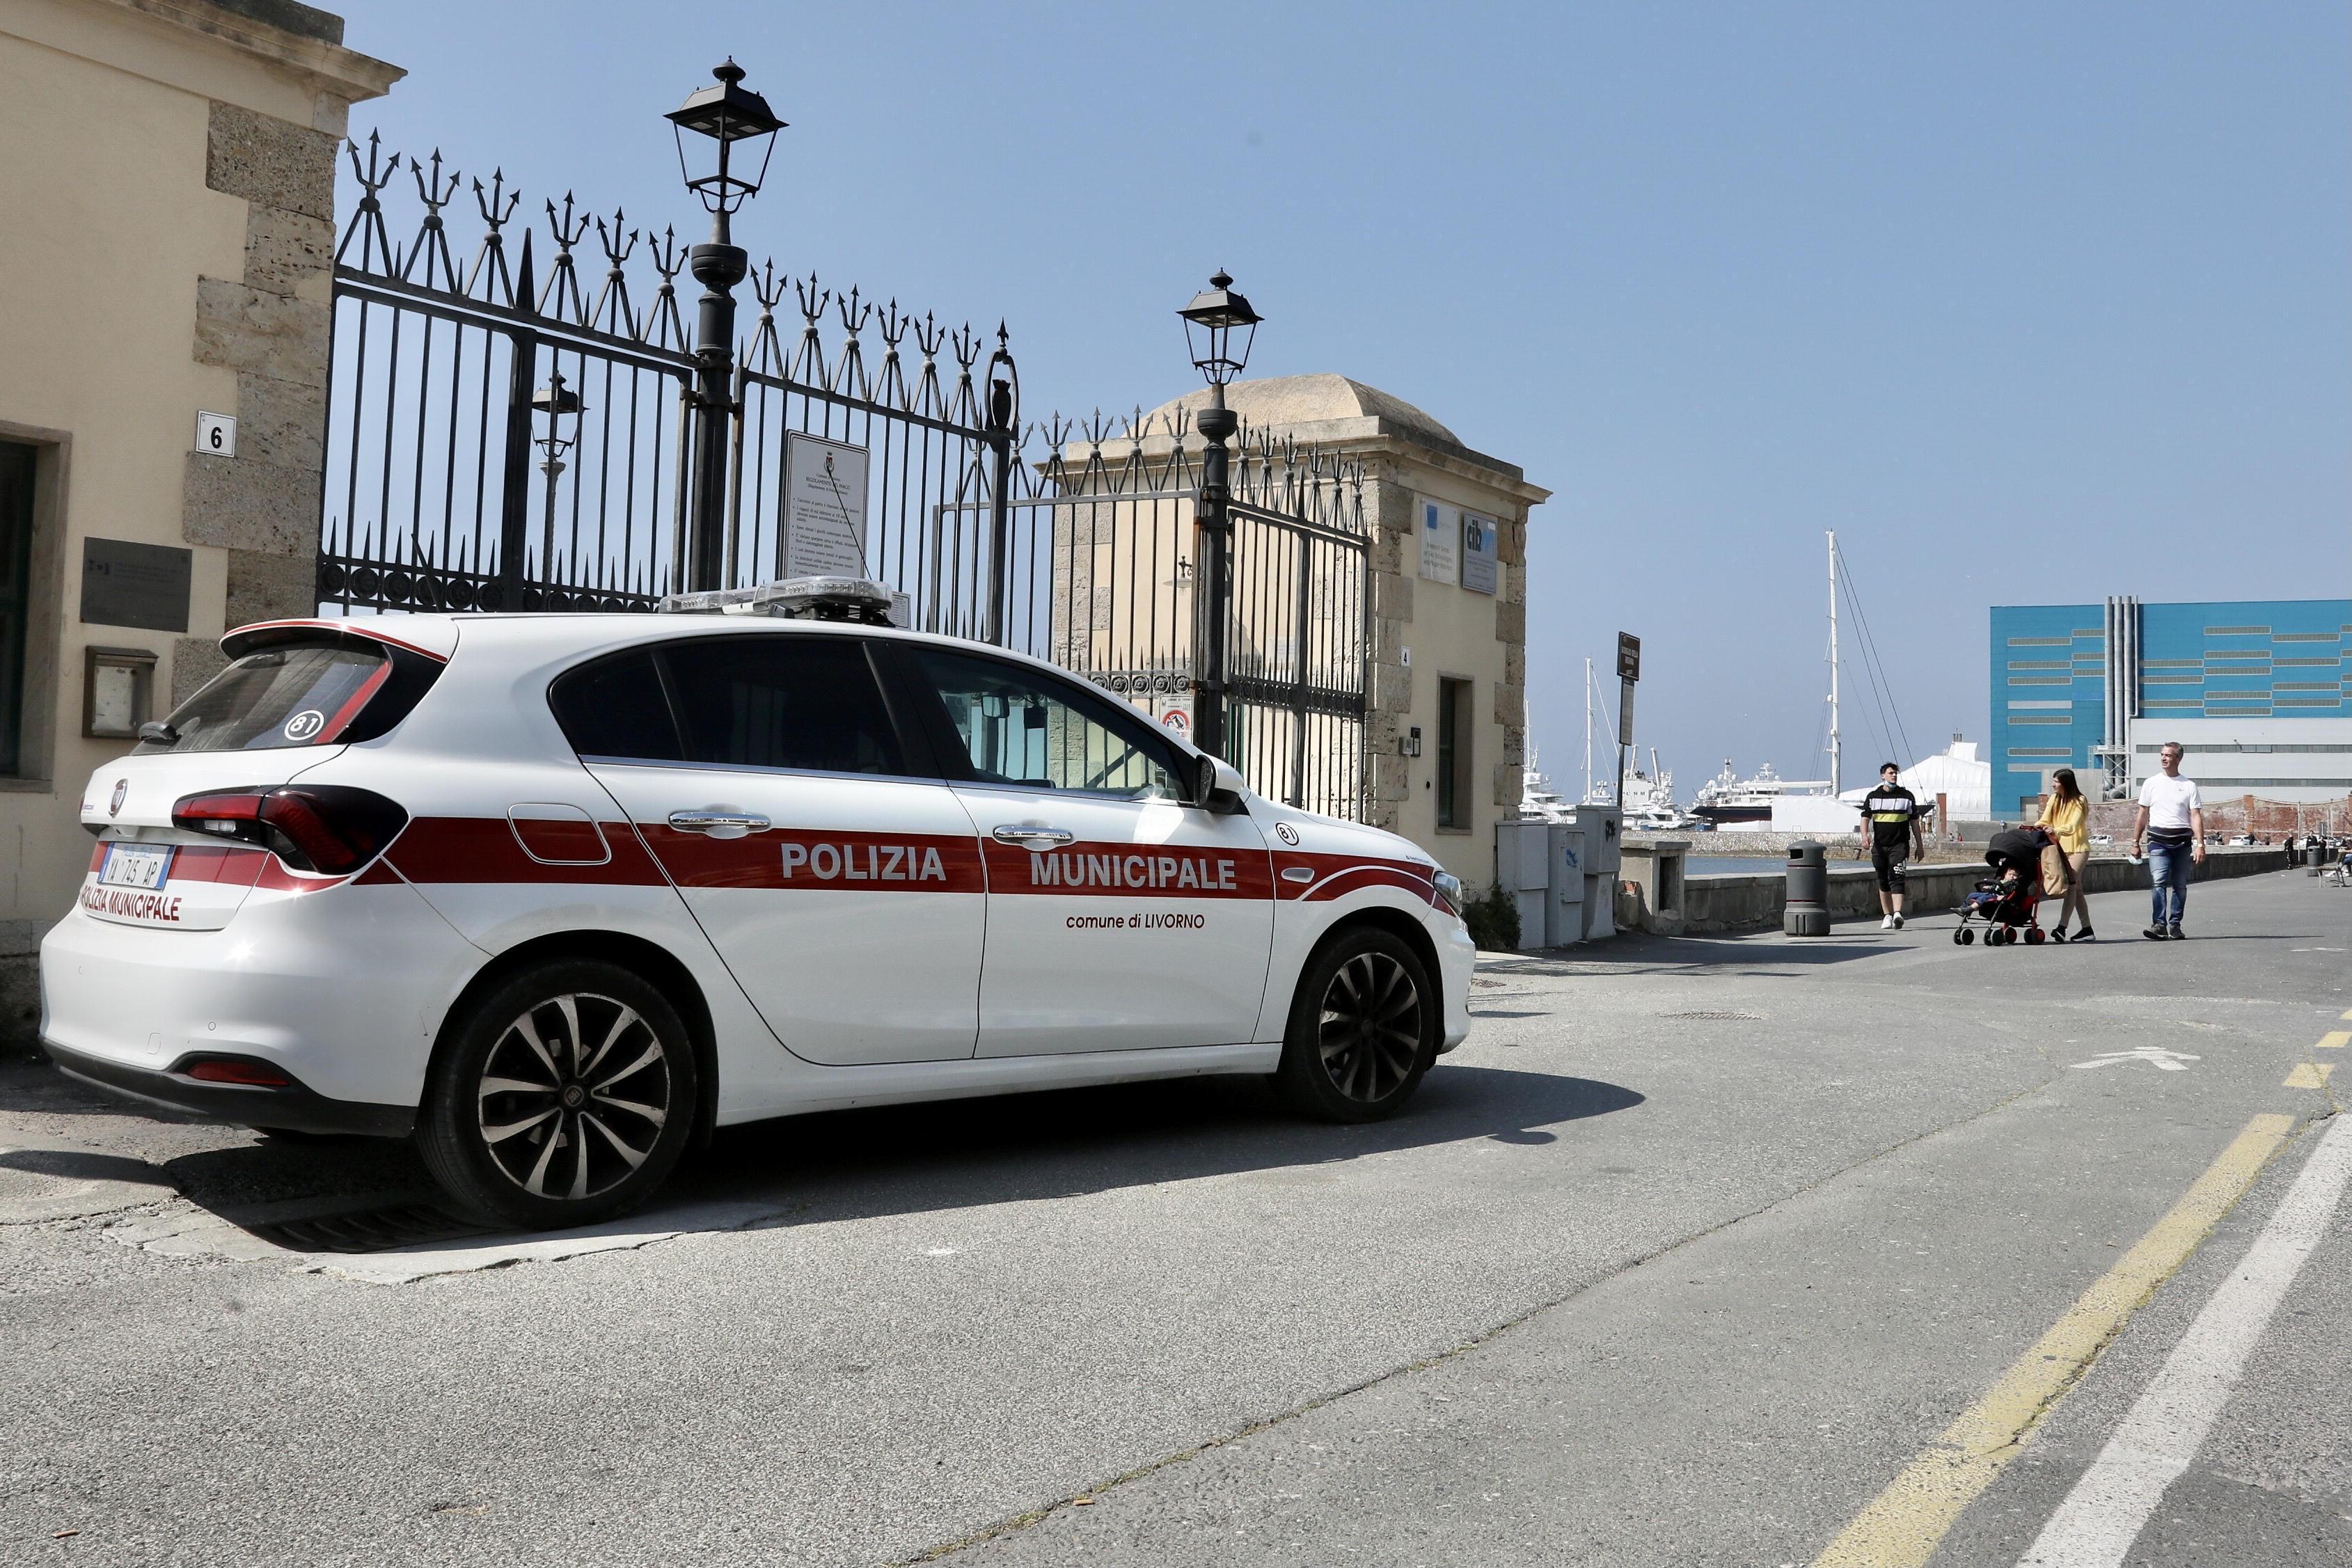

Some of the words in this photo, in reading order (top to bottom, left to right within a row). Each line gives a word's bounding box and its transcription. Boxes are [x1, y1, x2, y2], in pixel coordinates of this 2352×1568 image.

[211, 427, 222, 449] 6
[1404, 652, 1407, 663] 4
[290, 716, 318, 734] 81
[1279, 827, 1295, 839] 81
[143, 861, 157, 886] AP
[781, 843, 947, 881] POLIZIA
[1030, 853, 1237, 889] MUNICIPALE
[82, 885, 108, 912] POLIZIA
[109, 891, 182, 921] MUNICIPALE
[1066, 917, 1124, 928] comune
[1129, 913, 1141, 928] di
[1145, 913, 1205, 929] LIVORNO
